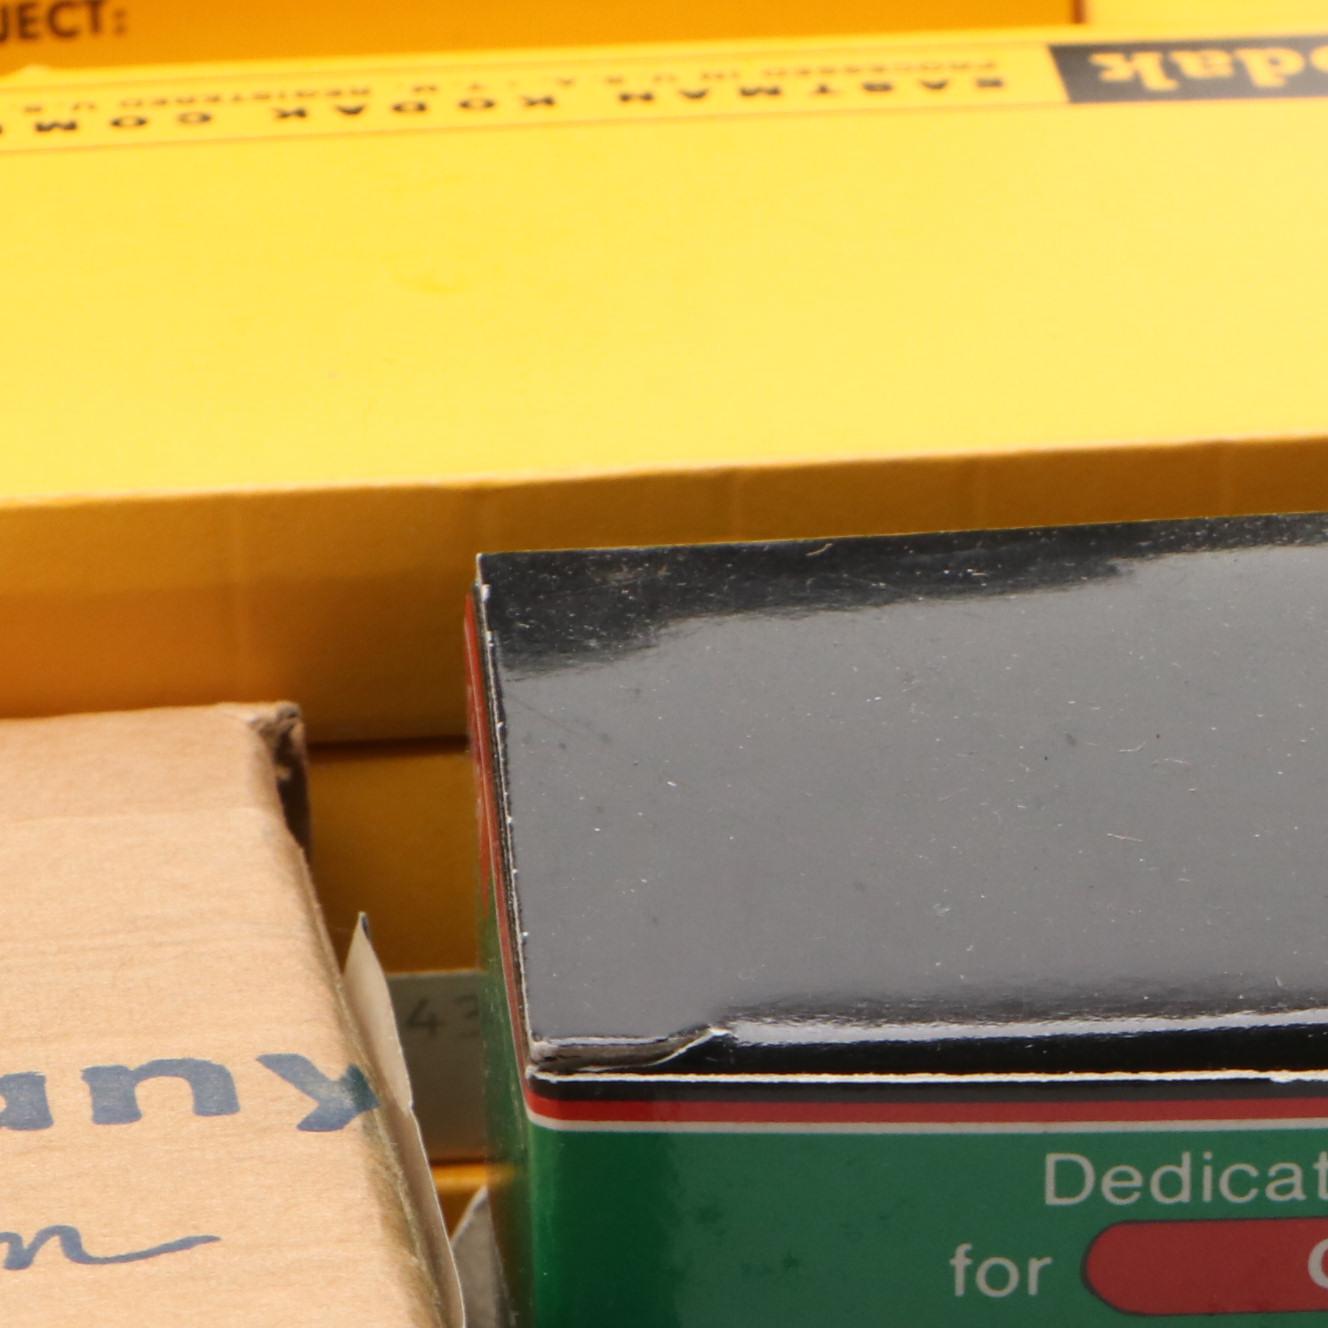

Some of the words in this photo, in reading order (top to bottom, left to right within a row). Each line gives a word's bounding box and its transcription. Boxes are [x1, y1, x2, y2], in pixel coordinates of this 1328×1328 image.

[617, 75, 1003, 105] EASTMAN
[274, 95, 557, 119] KODAK
[0, 112, 212, 134] COM
[949, 1243, 1052, 1298] for
